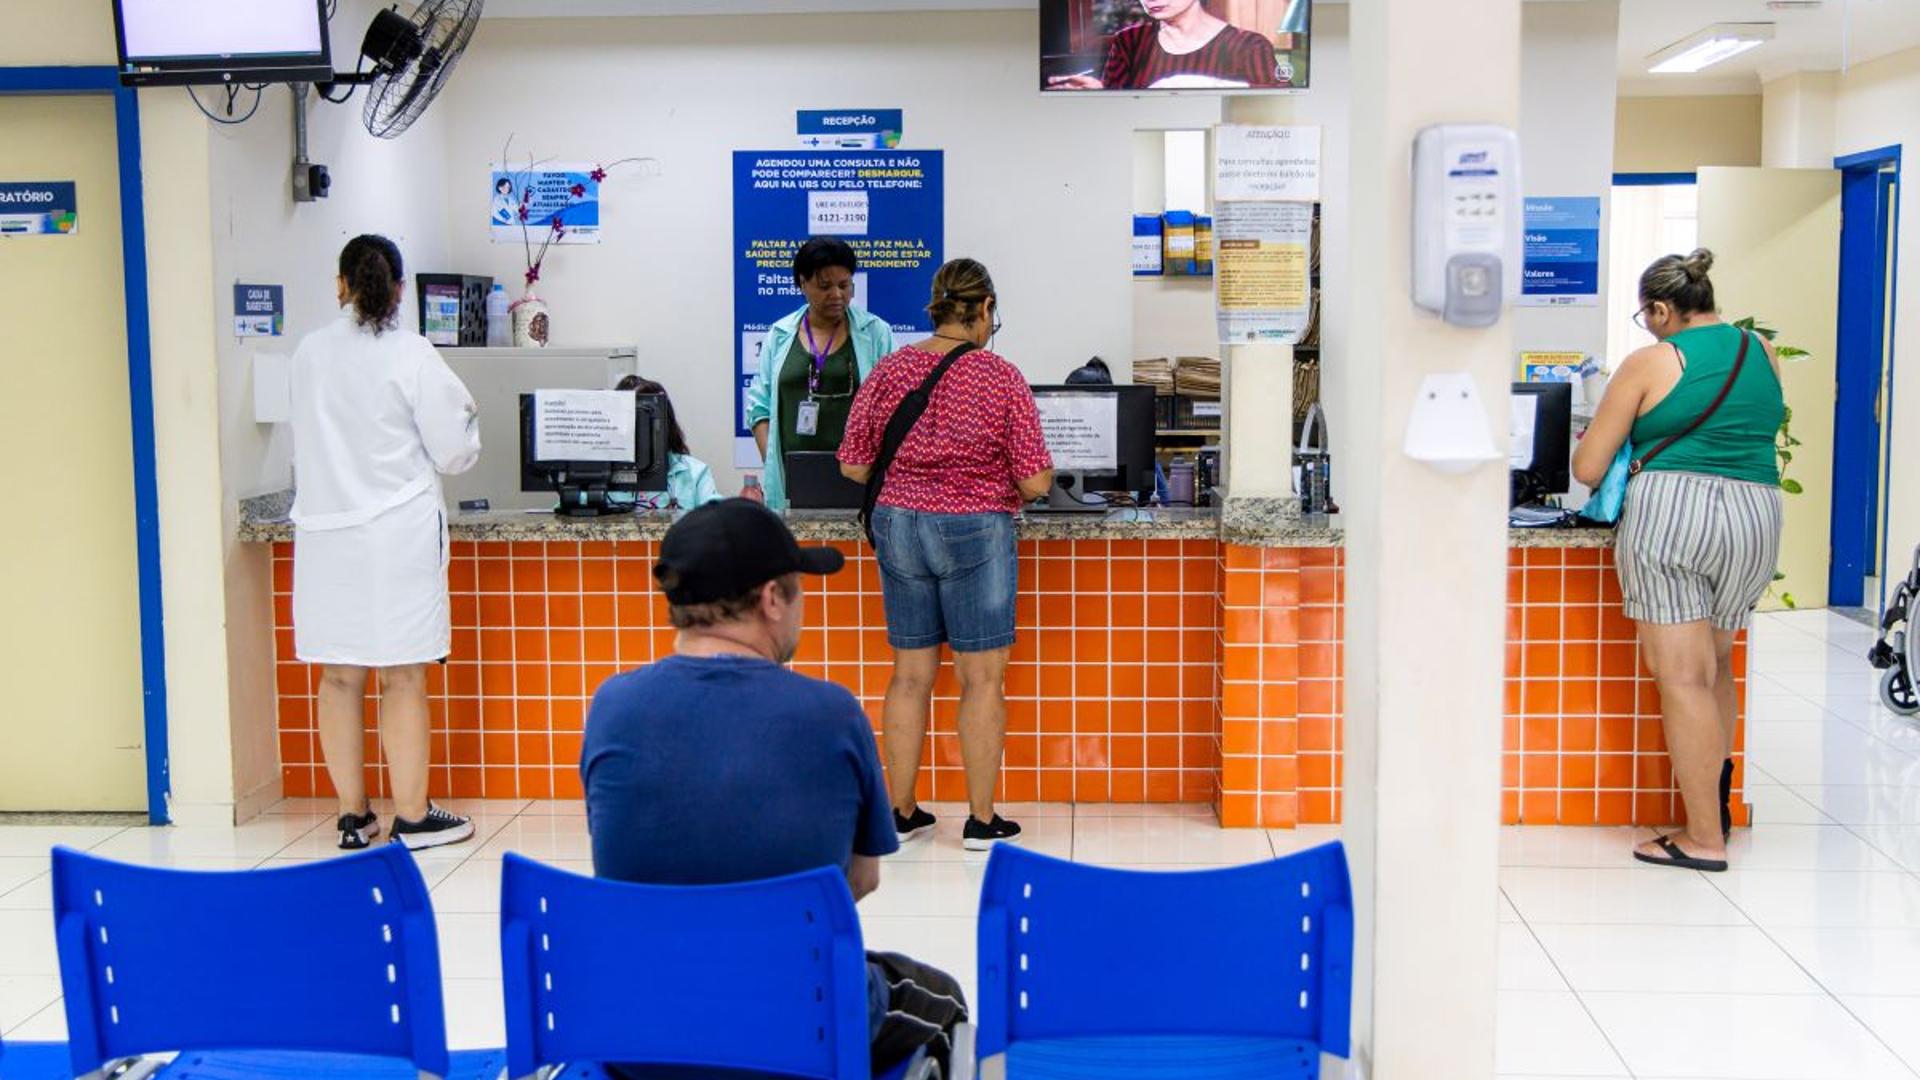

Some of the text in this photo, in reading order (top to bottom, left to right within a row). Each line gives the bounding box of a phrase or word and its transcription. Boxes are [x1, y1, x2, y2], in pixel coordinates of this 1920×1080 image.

[823, 115, 876, 126] RECEPÇÃO
[756, 159, 806, 167] AGENDOU
[808, 159, 831, 167] UMA
[833, 159, 886, 167] CONSULTA
[897, 157, 920, 167] NÃO
[752, 169, 780, 178] PODE
[782, 169, 856, 178] COMPARECER?
[754, 180, 923, 189] AQUI NA UBS OU PELO TELEFONE:
[752, 240, 787, 248] FALTAR
[789, 240, 796, 248] A
[873, 240, 893, 248] FAZ
[894, 240, 914, 248] MAL
[745, 249, 777, 258] SAÚDE
[779, 250, 793, 258] DE
[873, 250, 899, 258] PODE
[900, 250, 932, 258] ESTAR
[856, 260, 920, 268] TENDIMENTO
[758, 287, 774, 295] no
